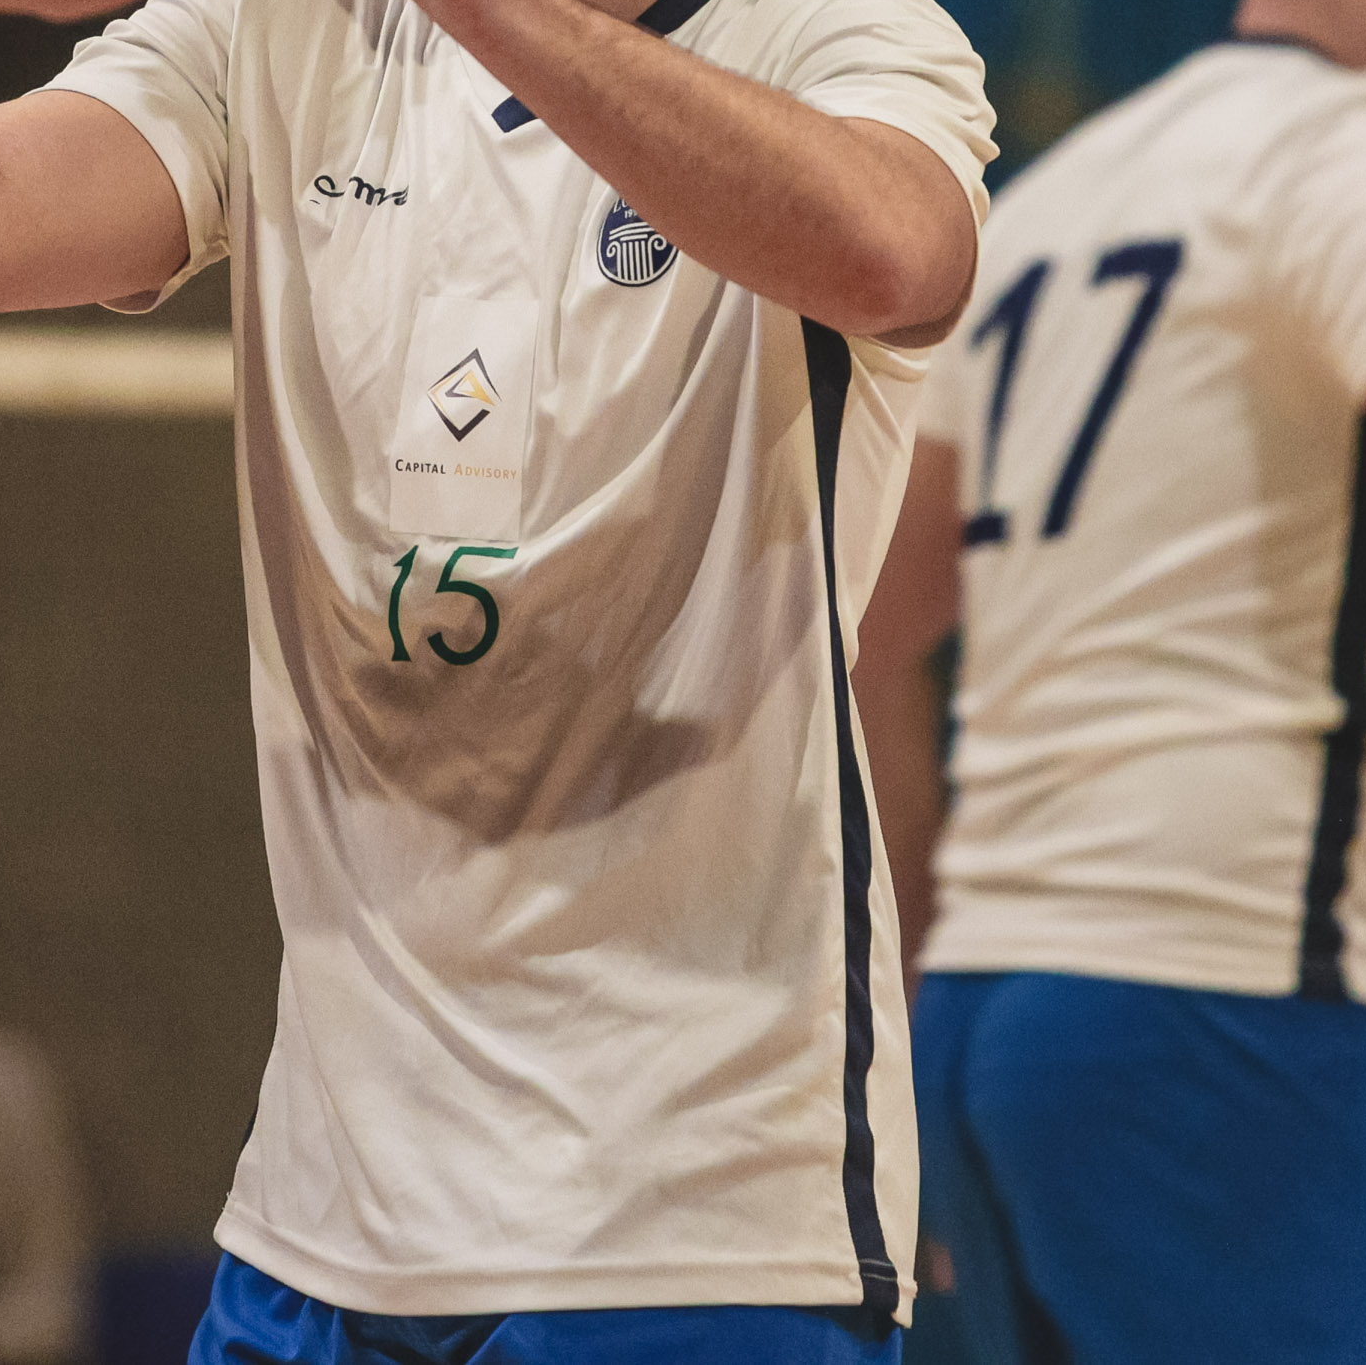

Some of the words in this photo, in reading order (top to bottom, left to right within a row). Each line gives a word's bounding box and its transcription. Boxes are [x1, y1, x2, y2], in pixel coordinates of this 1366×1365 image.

[963, 236, 1187, 548] 17
[395, 458, 447, 475] CAPITAL
[453, 463, 517, 480] ADVISORY
[388, 544, 520, 666] 15
